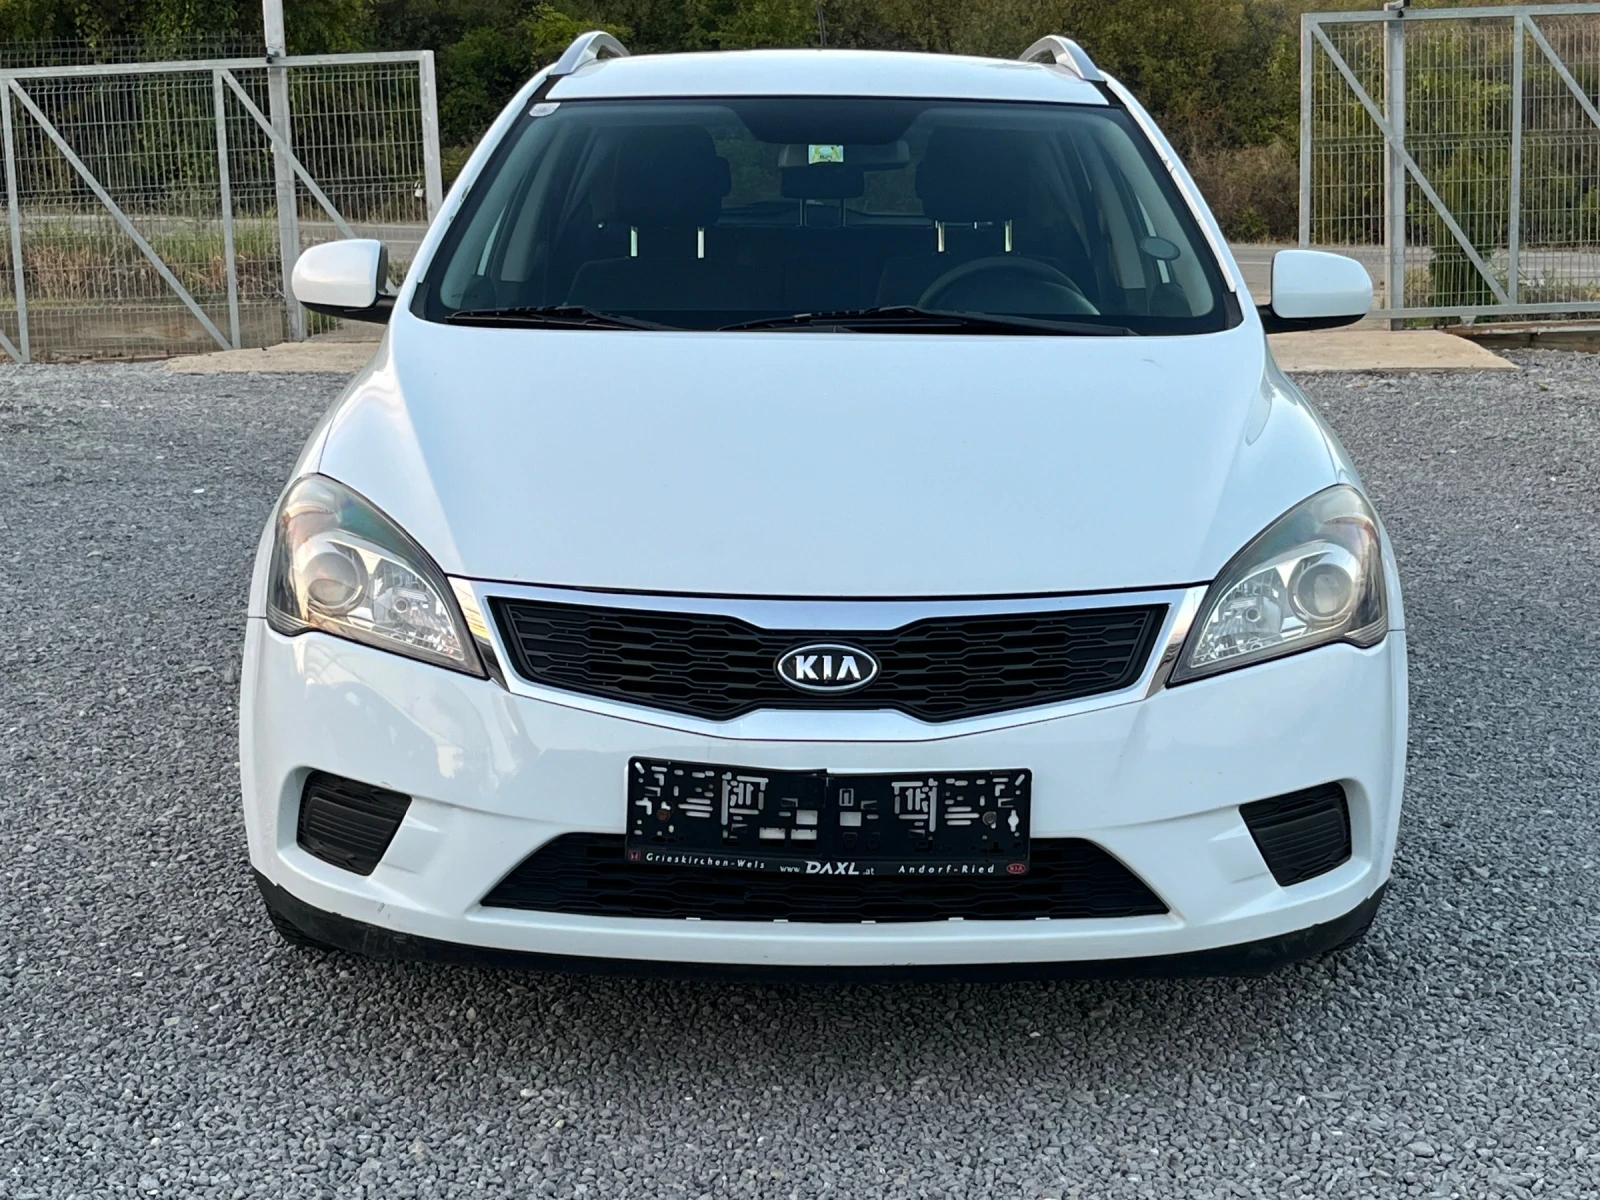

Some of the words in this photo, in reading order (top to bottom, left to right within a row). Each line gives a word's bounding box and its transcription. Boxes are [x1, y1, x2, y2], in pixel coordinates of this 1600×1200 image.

[795, 655, 861, 680] KIA
[646, 852, 765, 869] Grieskirchen-Wels
[805, 861, 859, 875] DAXL
[898, 864, 994, 874] Andorf-Ried
